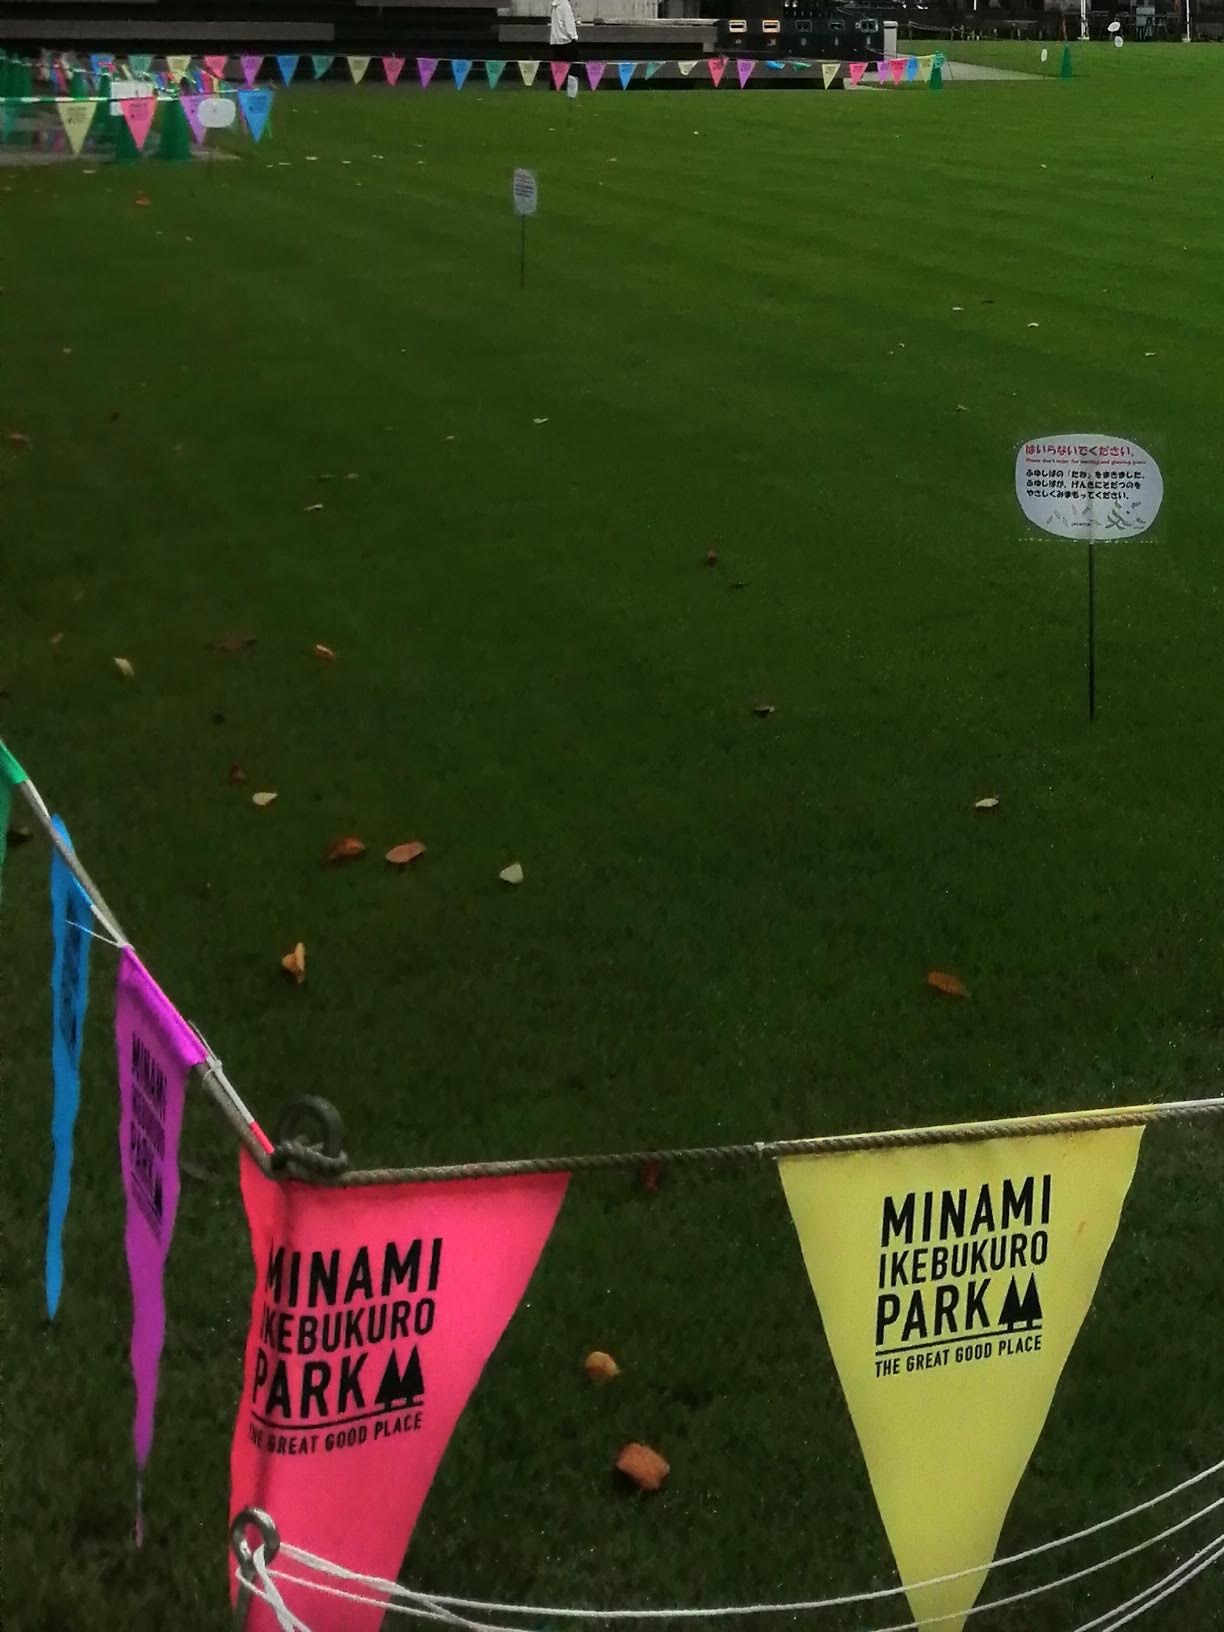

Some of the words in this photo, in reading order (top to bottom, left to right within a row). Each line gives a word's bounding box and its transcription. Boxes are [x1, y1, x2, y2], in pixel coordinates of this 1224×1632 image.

[1025, 444, 1134, 457] はいらないでください。
[881, 1174, 1051, 1247] MINAMI
[265, 1238, 443, 1308] MINAMI
[878, 1230, 1048, 1289] IKEBUKURO
[261, 1298, 436, 1355] IKEBUKURO
[875, 1278, 991, 1346] PARK
[252, 1347, 369, 1419] PARK
[875, 1359, 900, 1378] THE
[906, 1349, 949, 1372] GREAT
[955, 1342, 992, 1363] GOOD
[998, 1335, 1042, 1356] PLACE
[266, 1435, 319, 1456] GREAT
[325, 1426, 367, 1452] GOOD
[374, 1411, 423, 1441] PLACE
